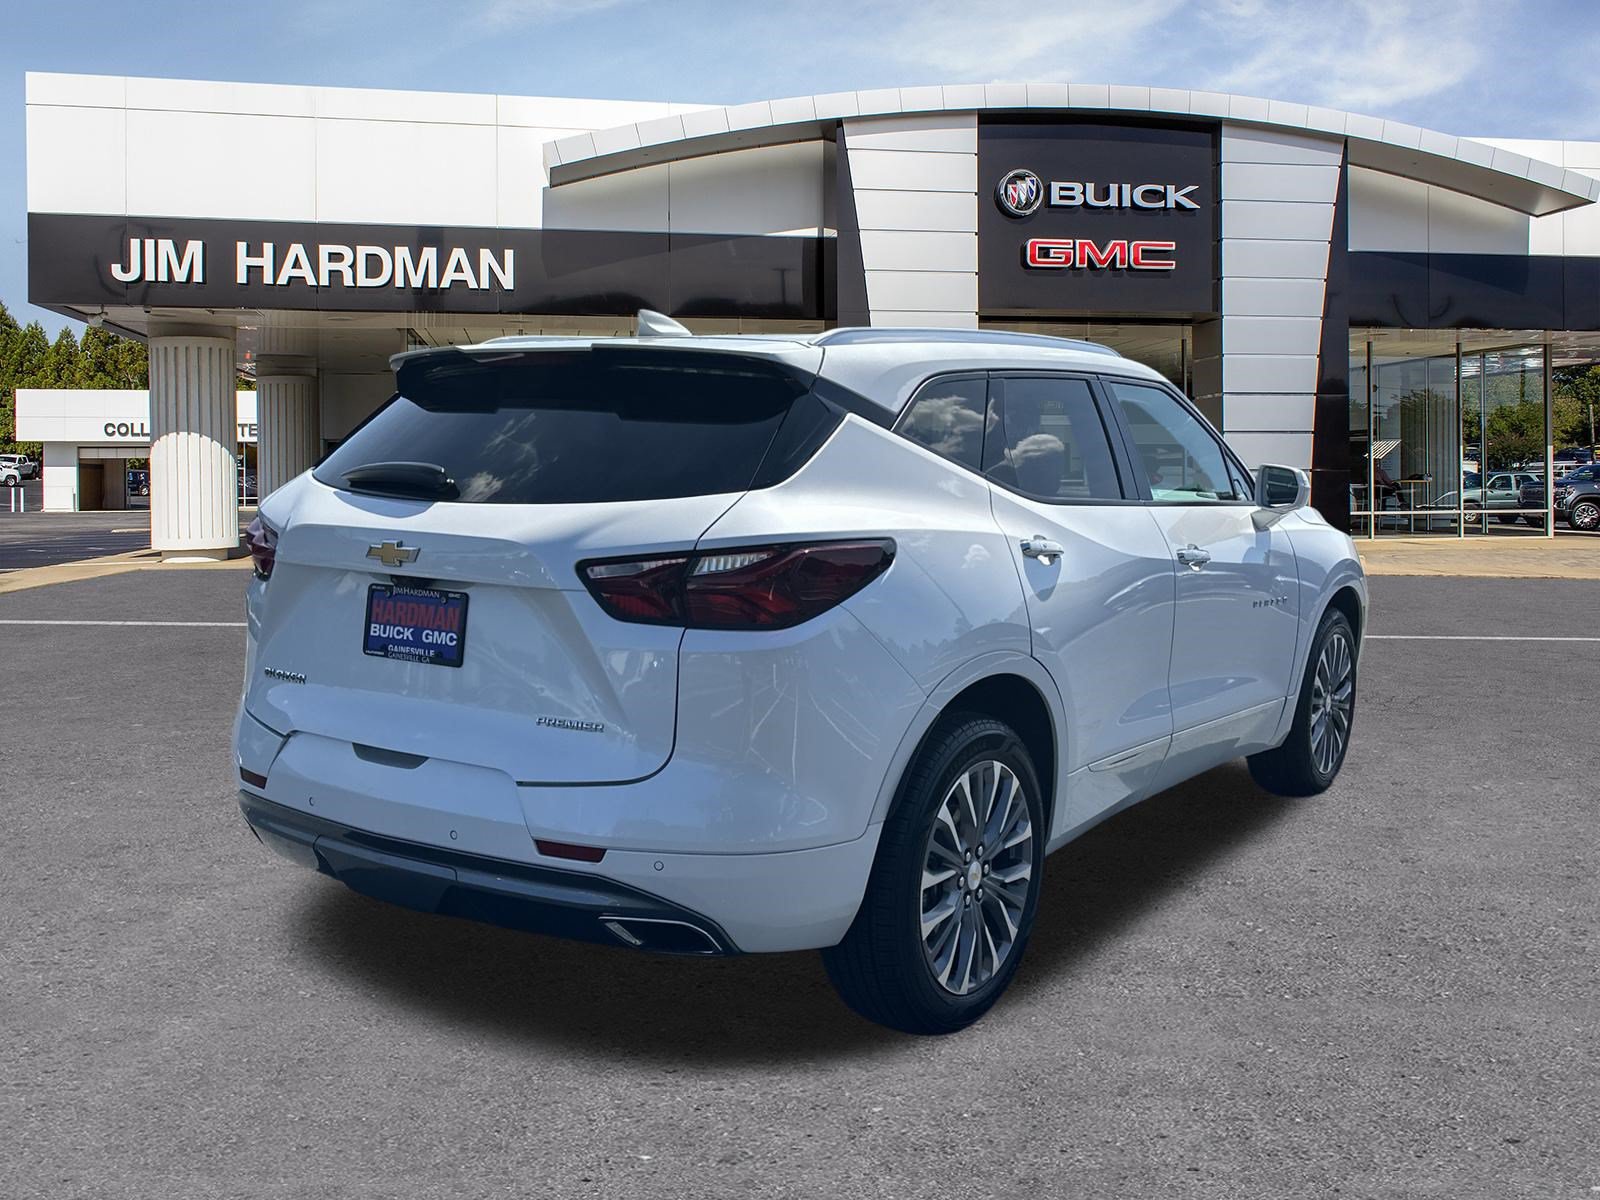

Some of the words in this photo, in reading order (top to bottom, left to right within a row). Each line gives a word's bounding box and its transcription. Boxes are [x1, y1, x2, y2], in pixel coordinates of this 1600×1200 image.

[1050, 181, 1200, 209] BUICK
[110, 238, 203, 284] JIM
[236, 240, 515, 291] HARDMAN
[1026, 238, 1176, 270] GMC
[371, 598, 460, 632] HARDMAN
[370, 623, 415, 641] BUICK
[421, 629, 458, 646] GMC
[387, 644, 435, 657] GAINESVILLE
[535, 716, 605, 733] PREMIER
